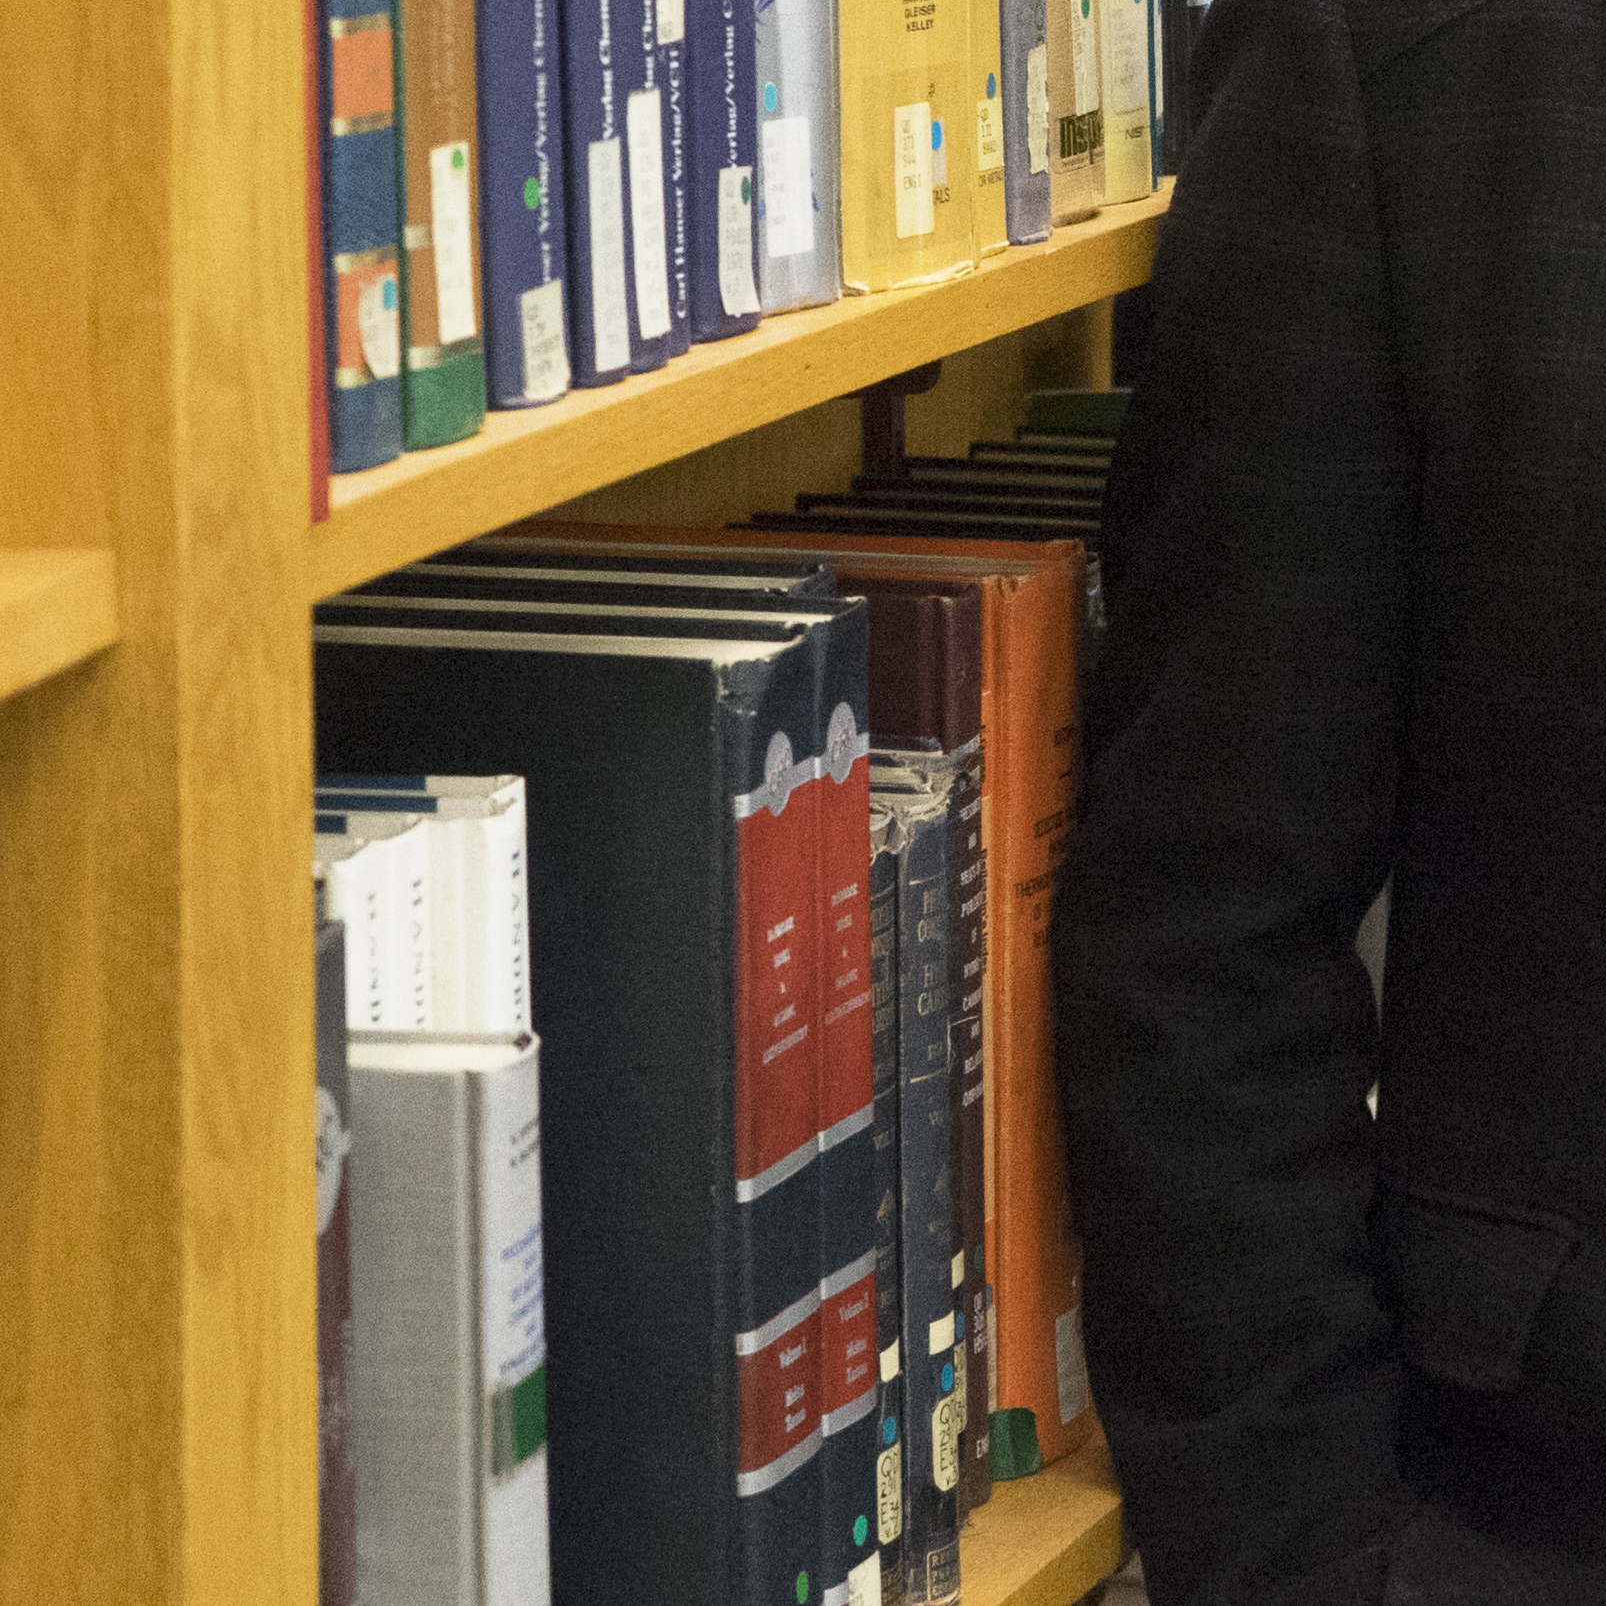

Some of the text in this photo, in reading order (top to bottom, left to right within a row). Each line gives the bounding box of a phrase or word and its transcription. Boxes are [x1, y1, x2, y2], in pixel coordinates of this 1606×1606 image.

[904, 3, 936, 20] GLEISER
[906, 18, 934, 34] KELLEY
[668, 48, 684, 182] Verlag/VCH
[673, 186, 686, 266] Hanser
[674, 271, 686, 319] Carl
